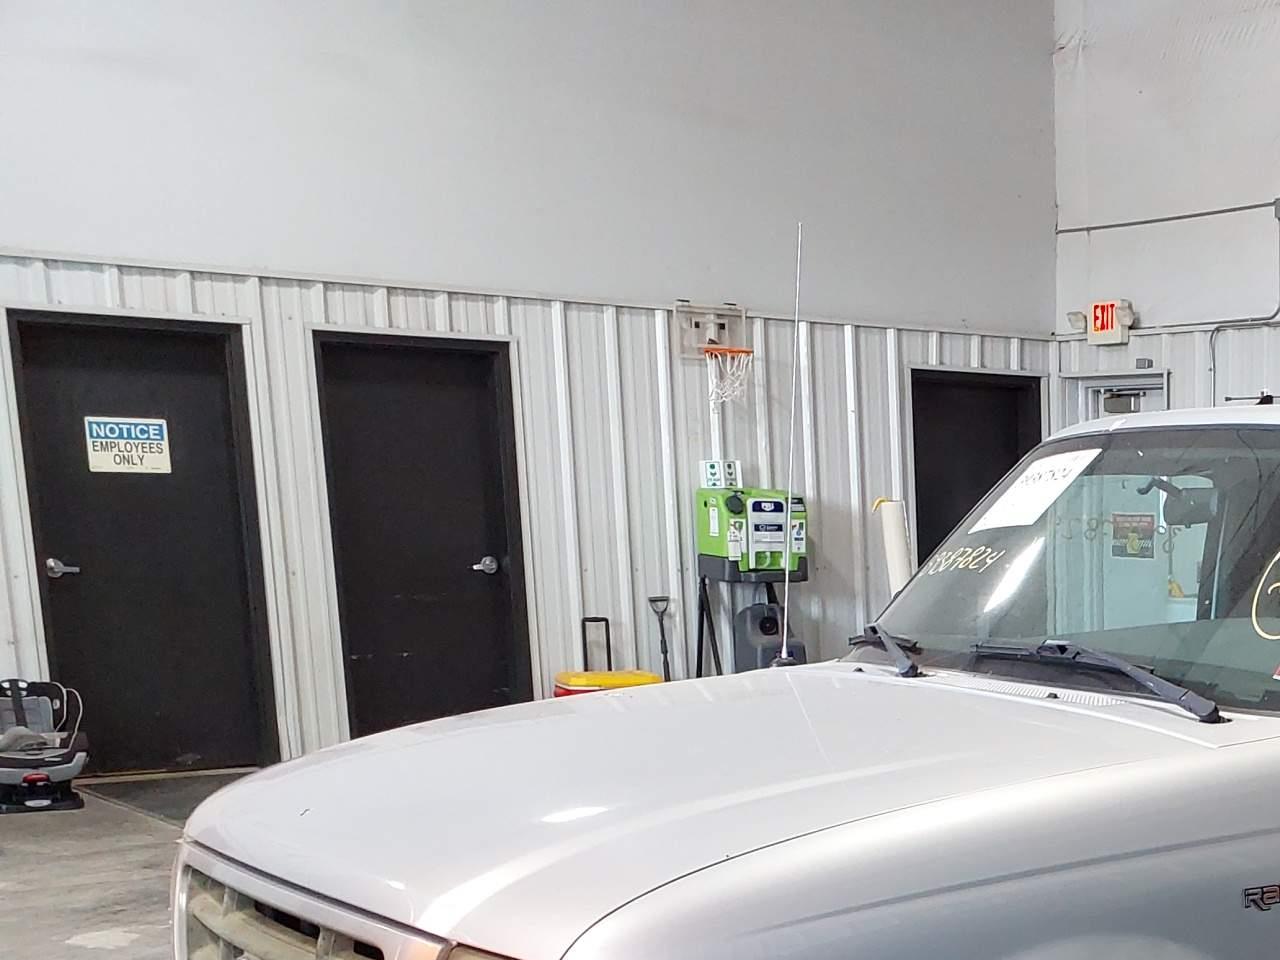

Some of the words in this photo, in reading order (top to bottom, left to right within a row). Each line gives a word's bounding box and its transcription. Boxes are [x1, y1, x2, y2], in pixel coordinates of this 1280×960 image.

[1093, 303, 1115, 332] EXIT
[91, 423, 162, 440] NOTICE
[92, 440, 164, 455] EMPLOYEES
[113, 453, 145, 467] ONLY
